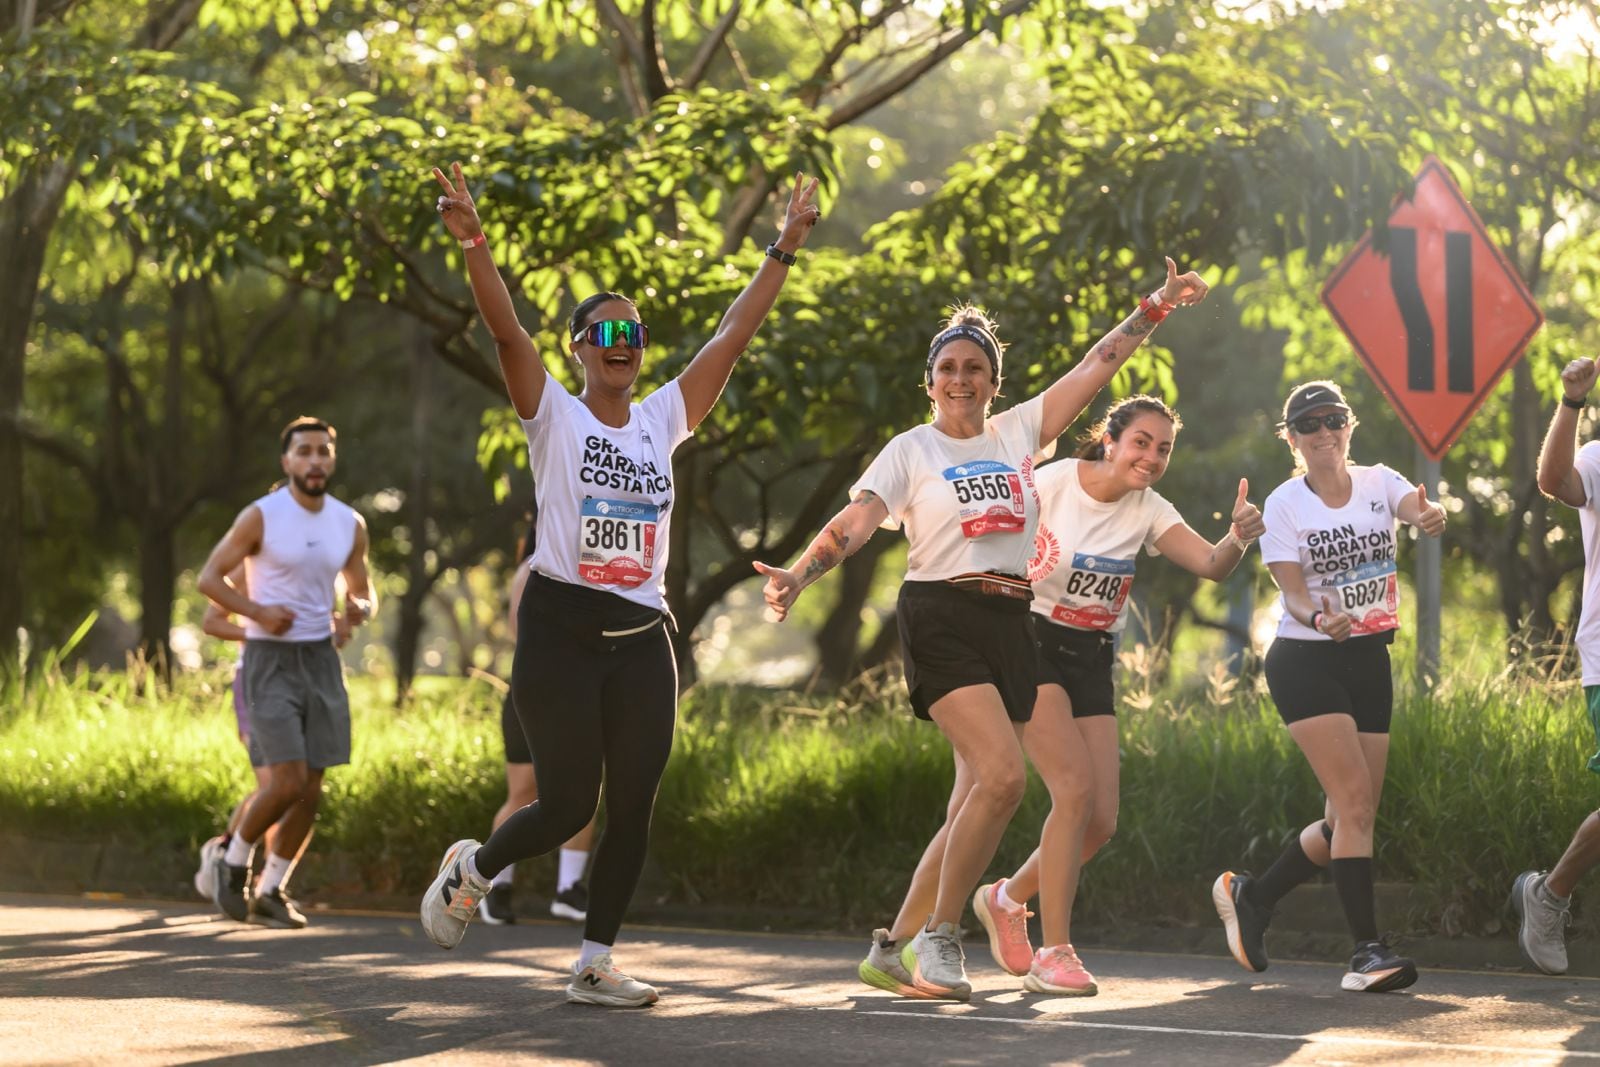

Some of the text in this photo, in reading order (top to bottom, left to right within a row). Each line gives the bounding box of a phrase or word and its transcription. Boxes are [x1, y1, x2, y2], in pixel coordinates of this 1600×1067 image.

[580, 466, 643, 494] COSTA
[953, 474, 1011, 504] 5556
[1013, 493, 1023, 504] 21
[585, 518, 641, 552] 3861
[1307, 523, 1356, 547] GRAN
[1309, 528, 1392, 561] MARATÓN
[586, 568, 605, 580] ICT
[1313, 552, 1367, 575] COSTA
[1066, 570, 1122, 602] 6248
[1342, 576, 1387, 609] 6037
[1060, 610, 1077, 621] ICT
